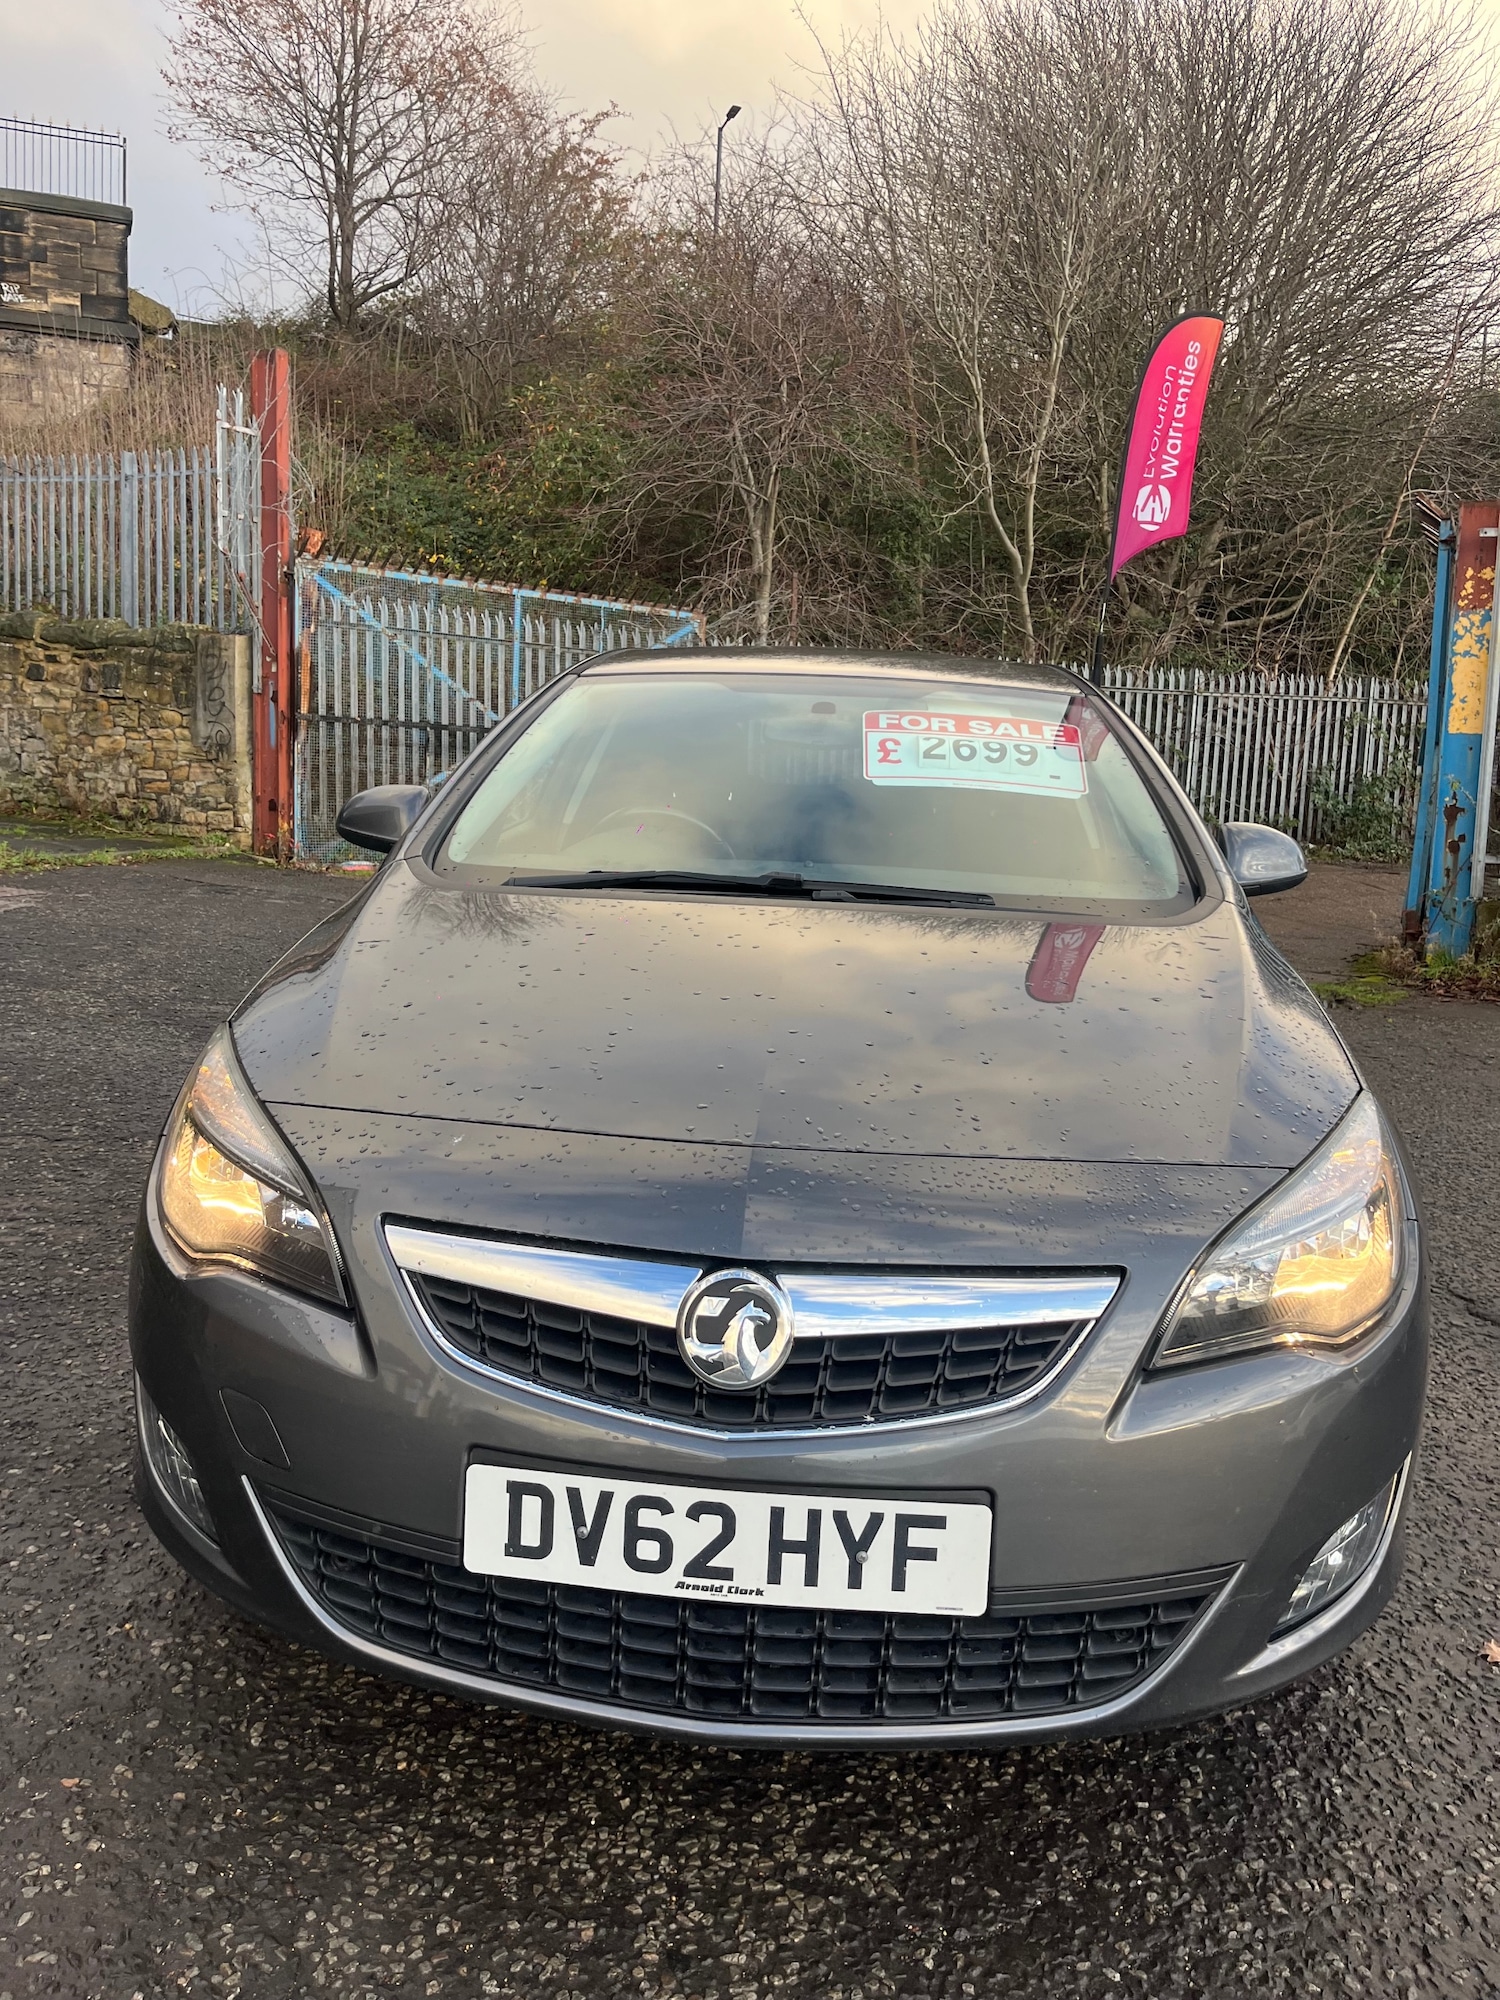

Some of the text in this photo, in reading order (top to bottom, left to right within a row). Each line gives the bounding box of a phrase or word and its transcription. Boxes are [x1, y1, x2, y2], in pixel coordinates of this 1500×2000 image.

[1143, 365, 1177, 478] Evolution
[1160, 340, 1201, 479] Warranties
[877, 736, 1039, 766] £ 2699
[878, 714, 1066, 742] FOR SALE
[504, 1480, 947, 1592] DV62 HYF
[674, 1581, 724, 1593] Arnold
[727, 1585, 764, 1597] Clark
